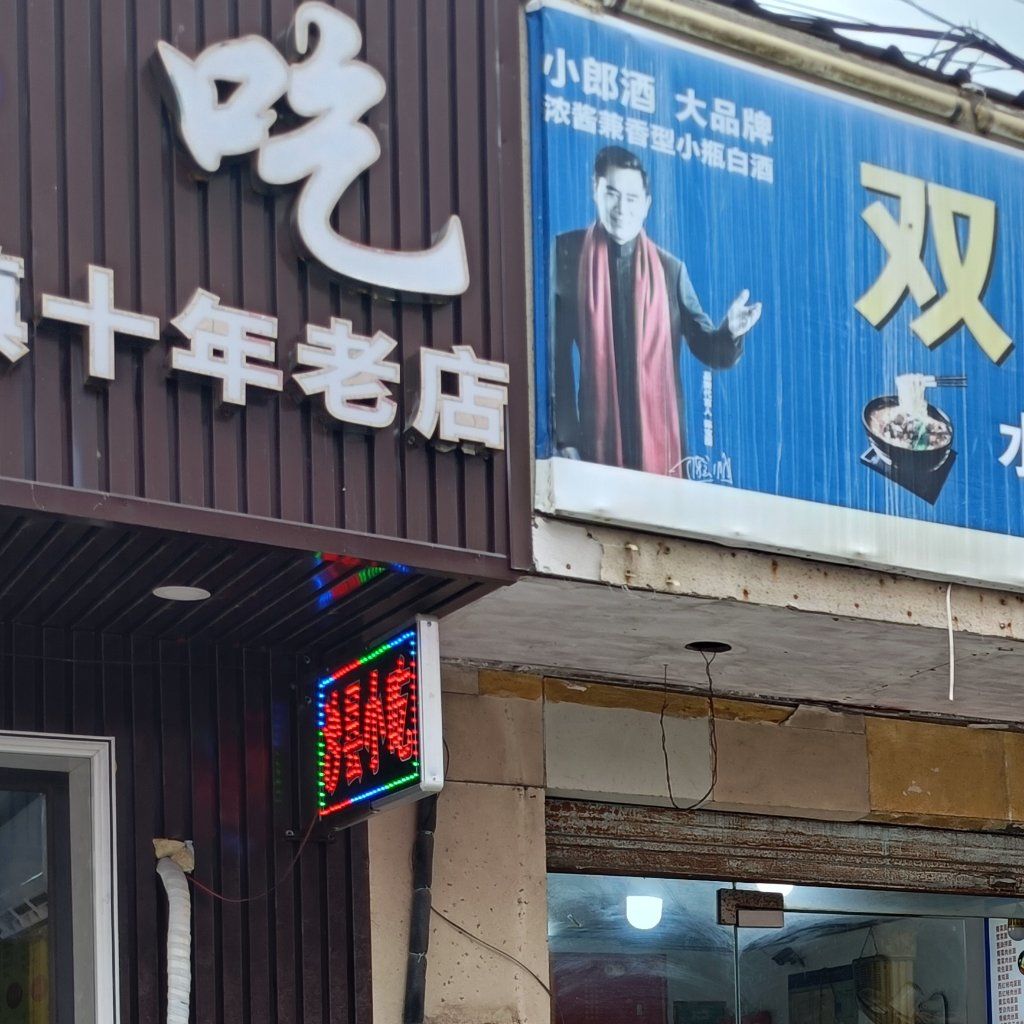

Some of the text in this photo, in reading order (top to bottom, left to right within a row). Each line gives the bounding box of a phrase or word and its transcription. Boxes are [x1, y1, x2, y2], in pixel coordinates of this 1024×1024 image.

[543, 48, 774, 147] 小郎酒 大品牌
[543, 94, 774, 185] 浓酱兼香型小瓶白酒
[156, 0, 470, 296] 吃
